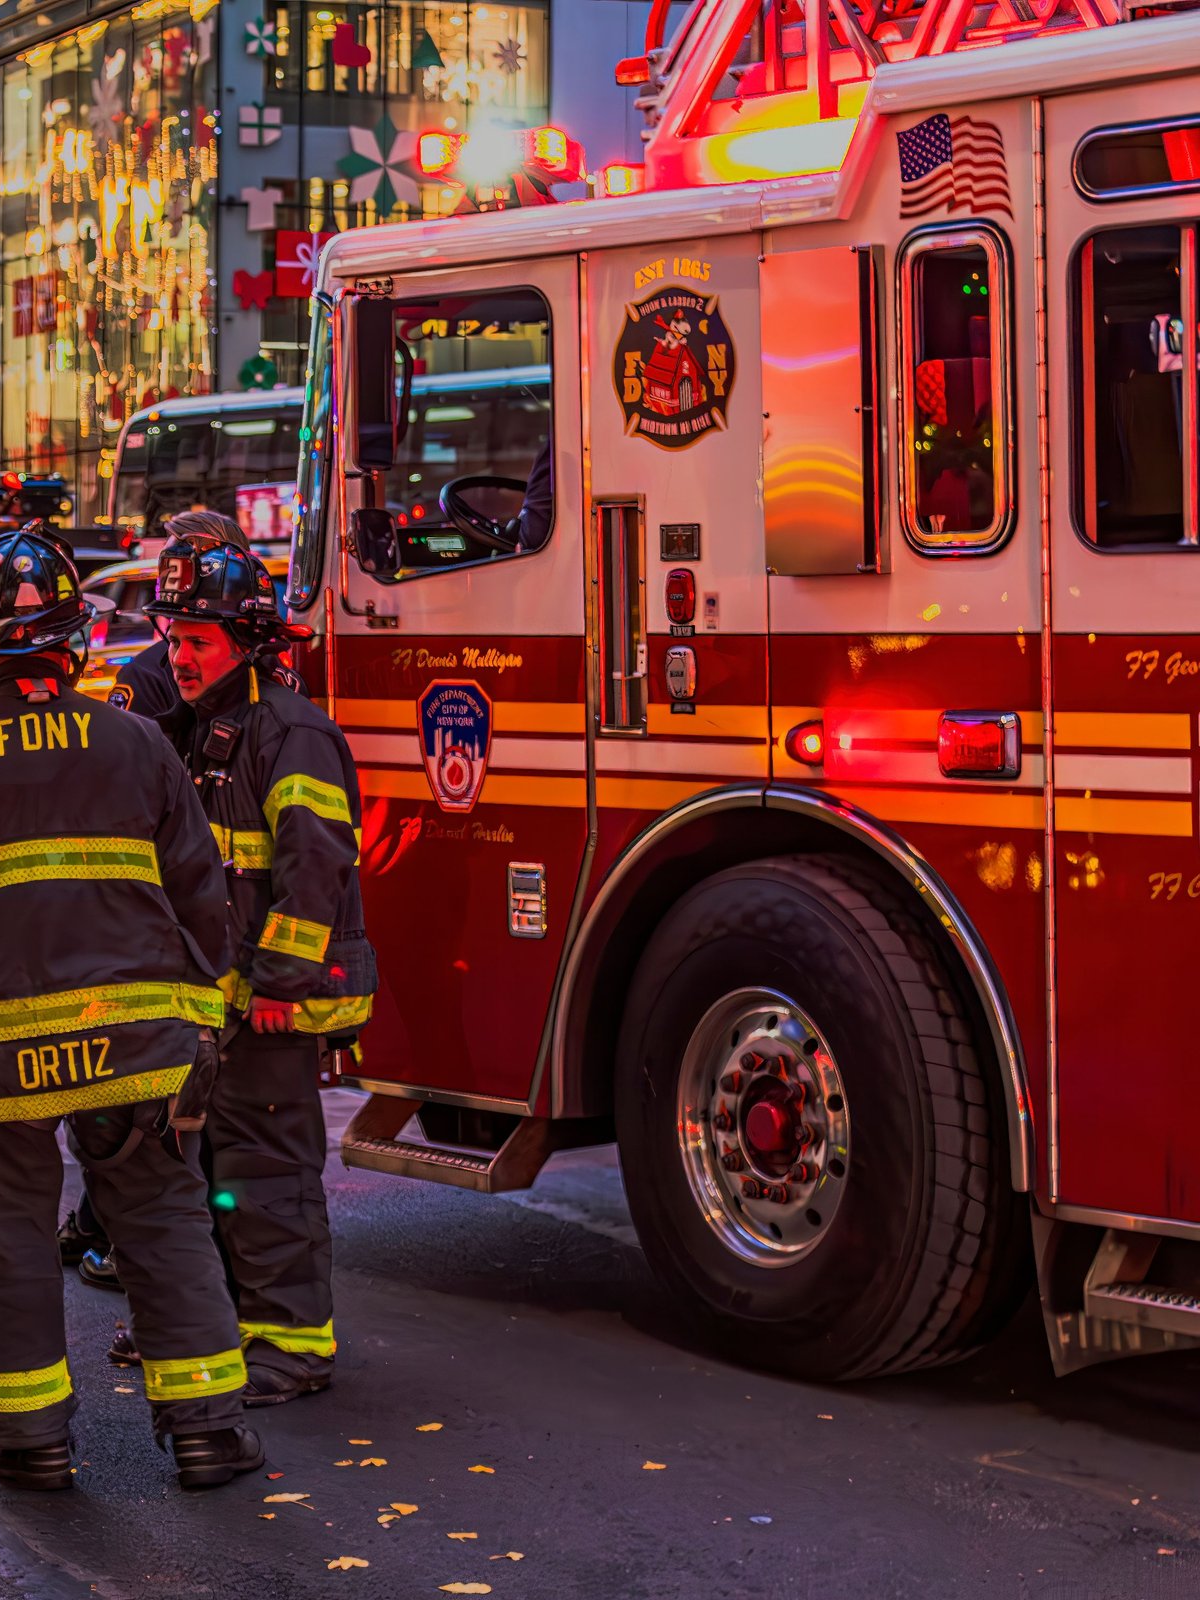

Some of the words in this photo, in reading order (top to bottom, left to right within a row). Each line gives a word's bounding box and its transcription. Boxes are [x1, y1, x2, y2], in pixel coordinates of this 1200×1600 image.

[634, 258, 666, 289] EST
[673, 257, 712, 282] 1865
[416, 648, 458, 668] Dennis
[462, 646, 523, 674] Mulligan
[1164, 650, 1200, 685] Geo
[436, 716, 453, 727] NEW
[453, 716, 475, 728] YORK
[441, 704, 458, 715] CITY
[458, 704, 469, 715] OF
[17, 1036, 114, 1090] ORTIZ
